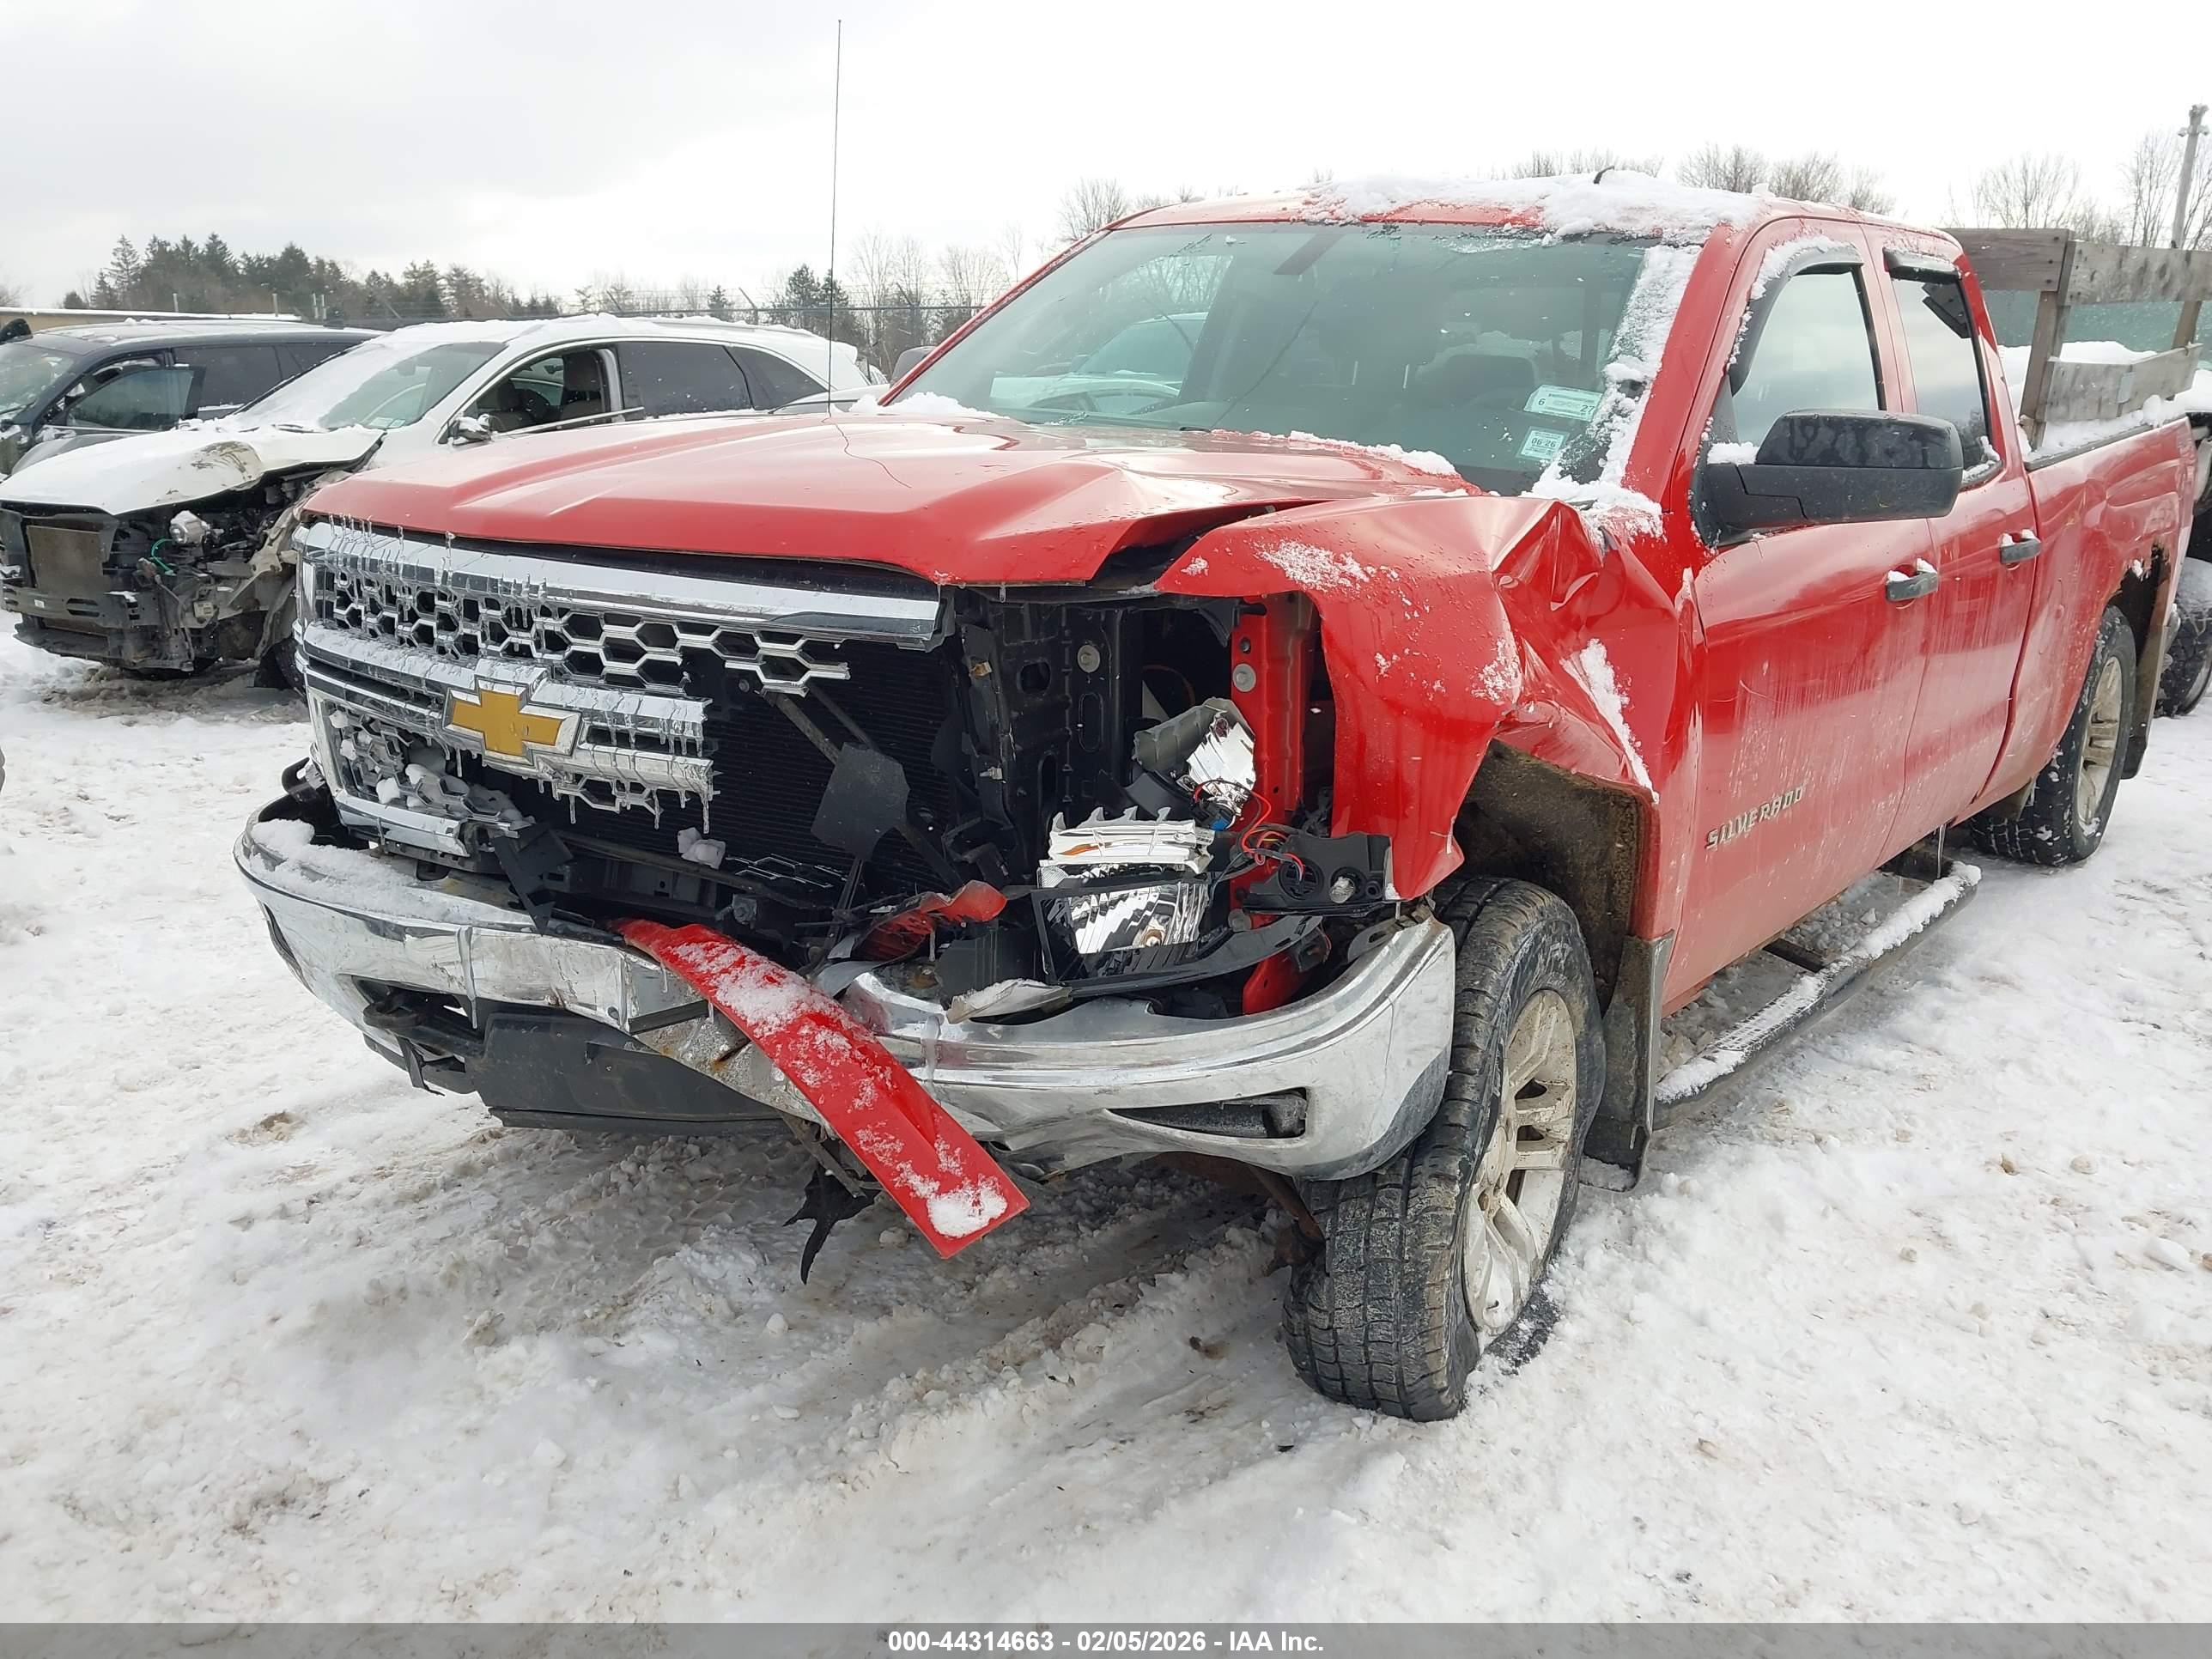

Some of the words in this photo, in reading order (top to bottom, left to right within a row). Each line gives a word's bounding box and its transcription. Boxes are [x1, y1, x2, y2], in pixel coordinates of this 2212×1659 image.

[1538, 398, 1547, 406] 6
[1579, 404, 1595, 413] 27
[1705, 784, 1806, 850] SILVERADO
